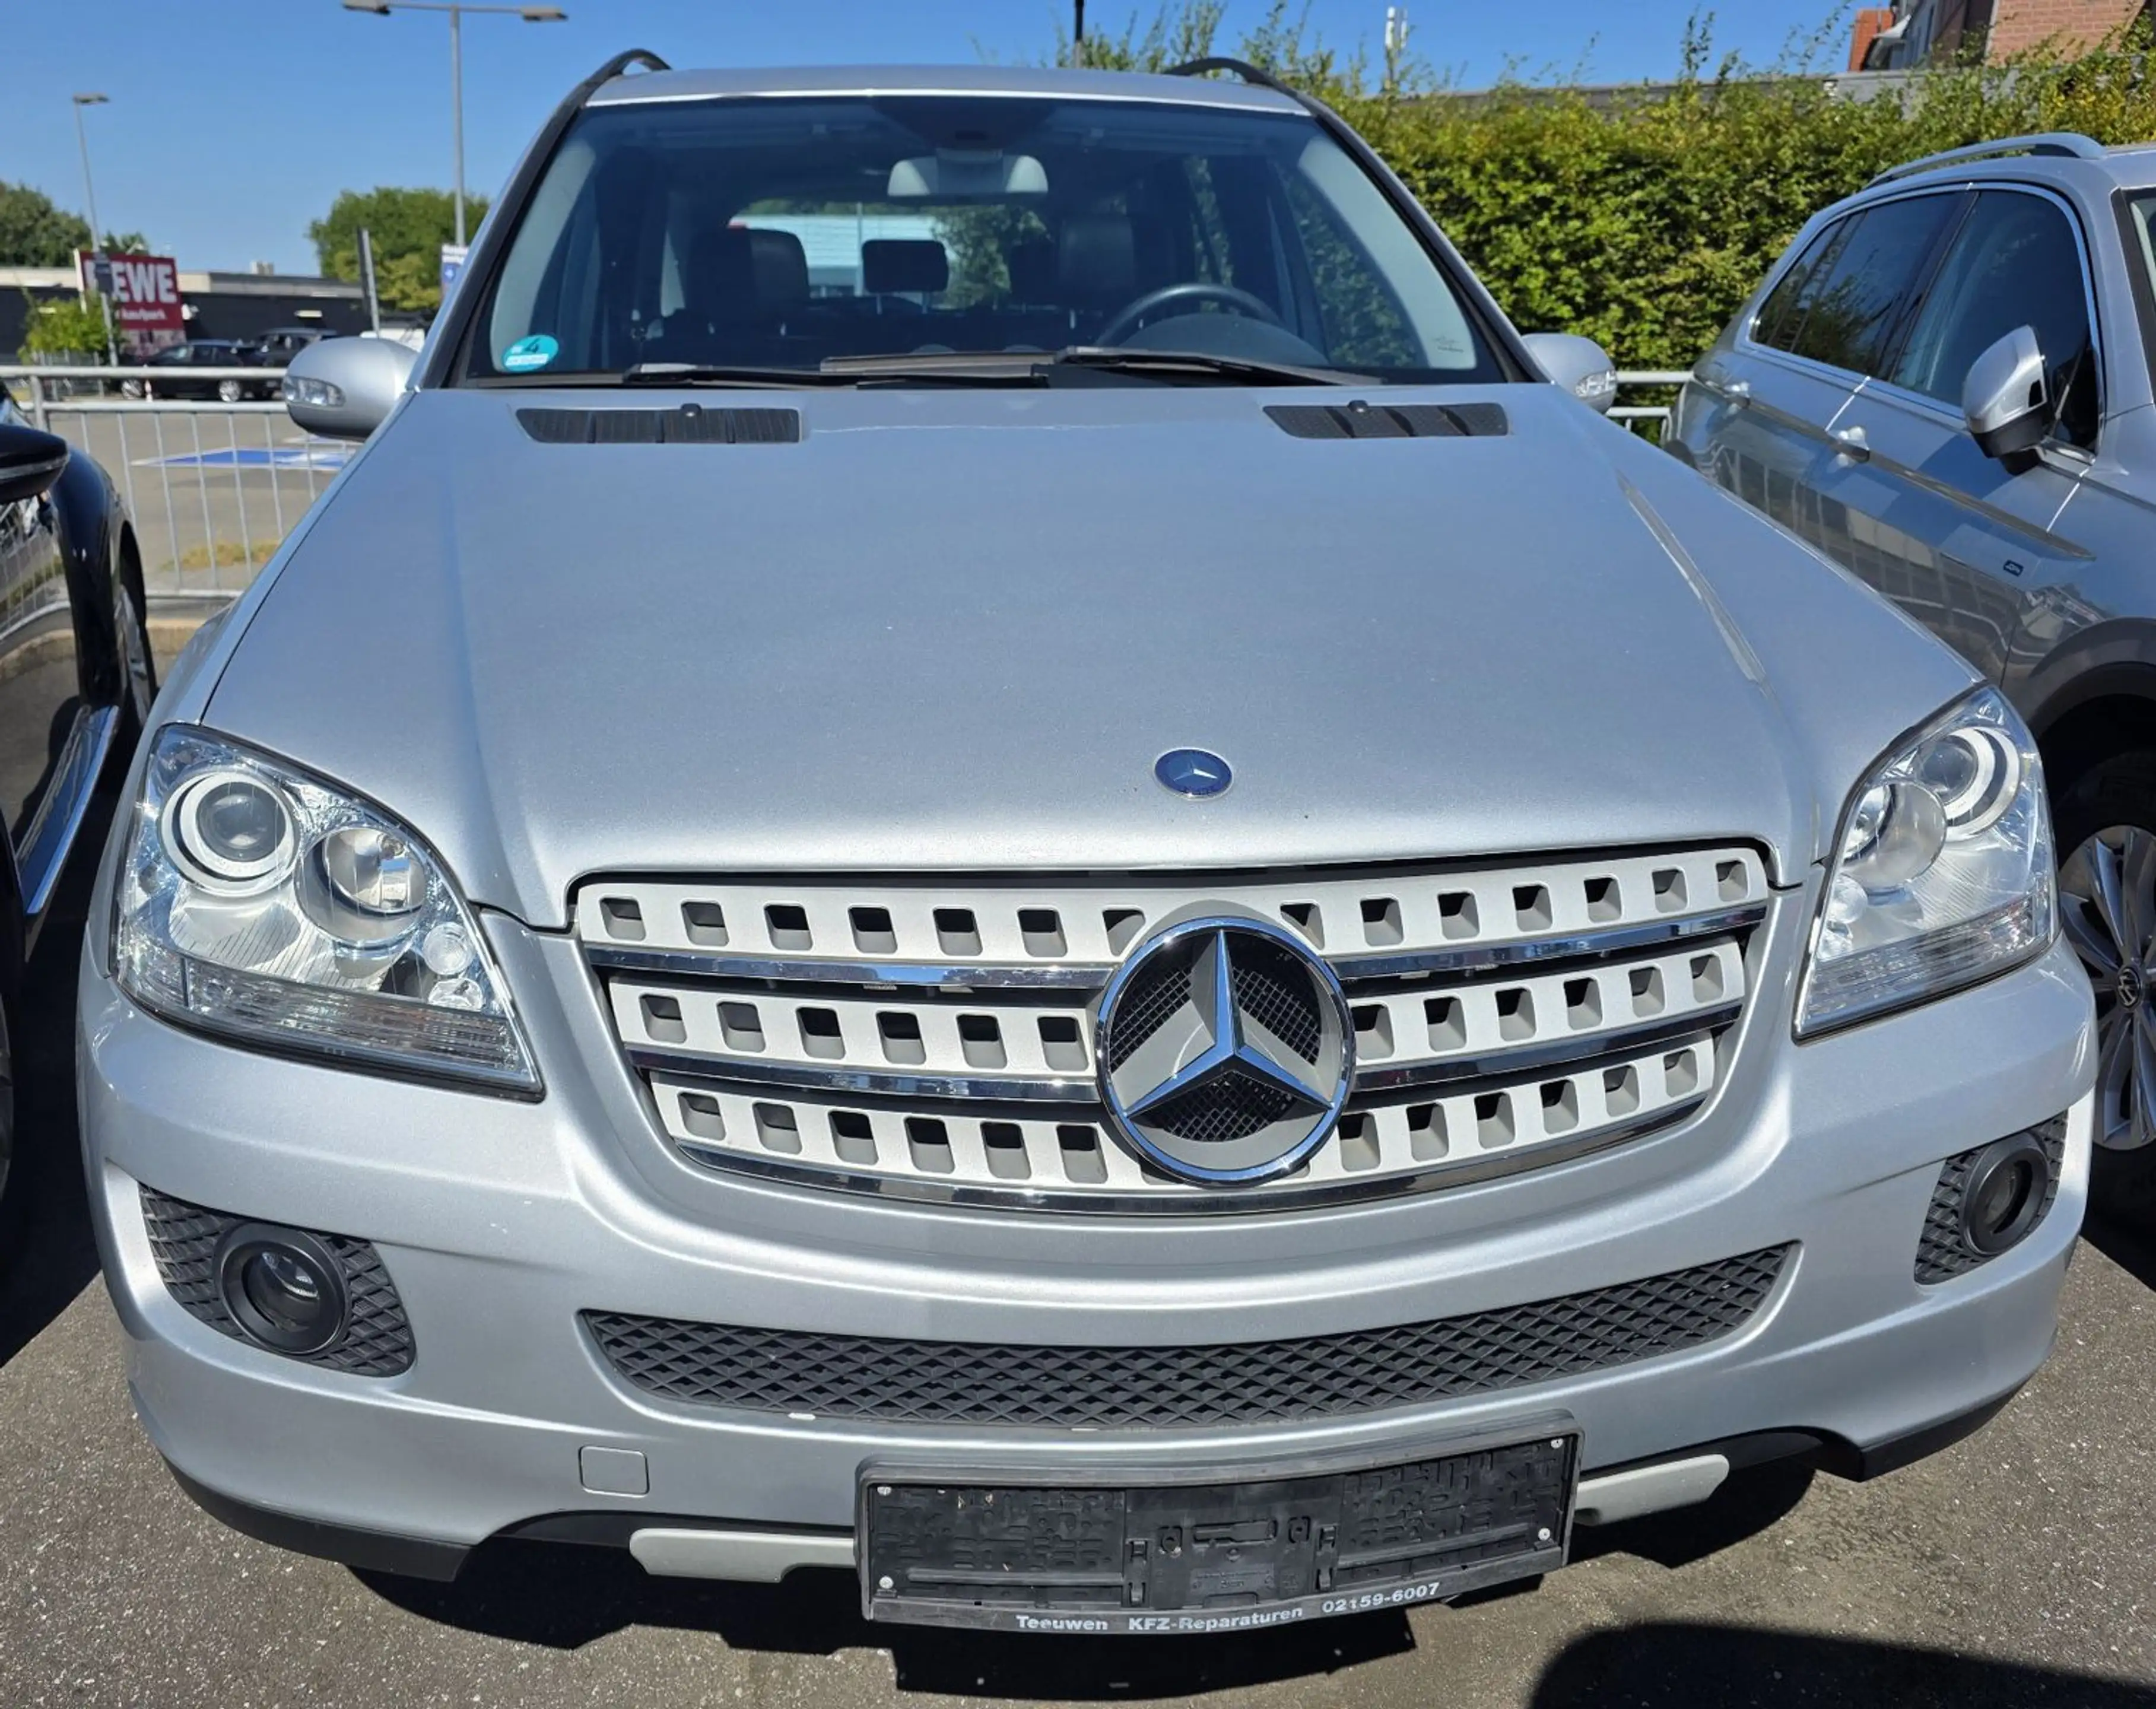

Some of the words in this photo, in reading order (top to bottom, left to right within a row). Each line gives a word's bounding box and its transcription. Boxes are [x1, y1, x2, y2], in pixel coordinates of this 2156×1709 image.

[1015, 1615, 1109, 1631] Teeuwen
[1129, 1608, 1303, 1631] KFZ-Reparaturen
[1322, 1582, 1440, 1613] 02159-6007
